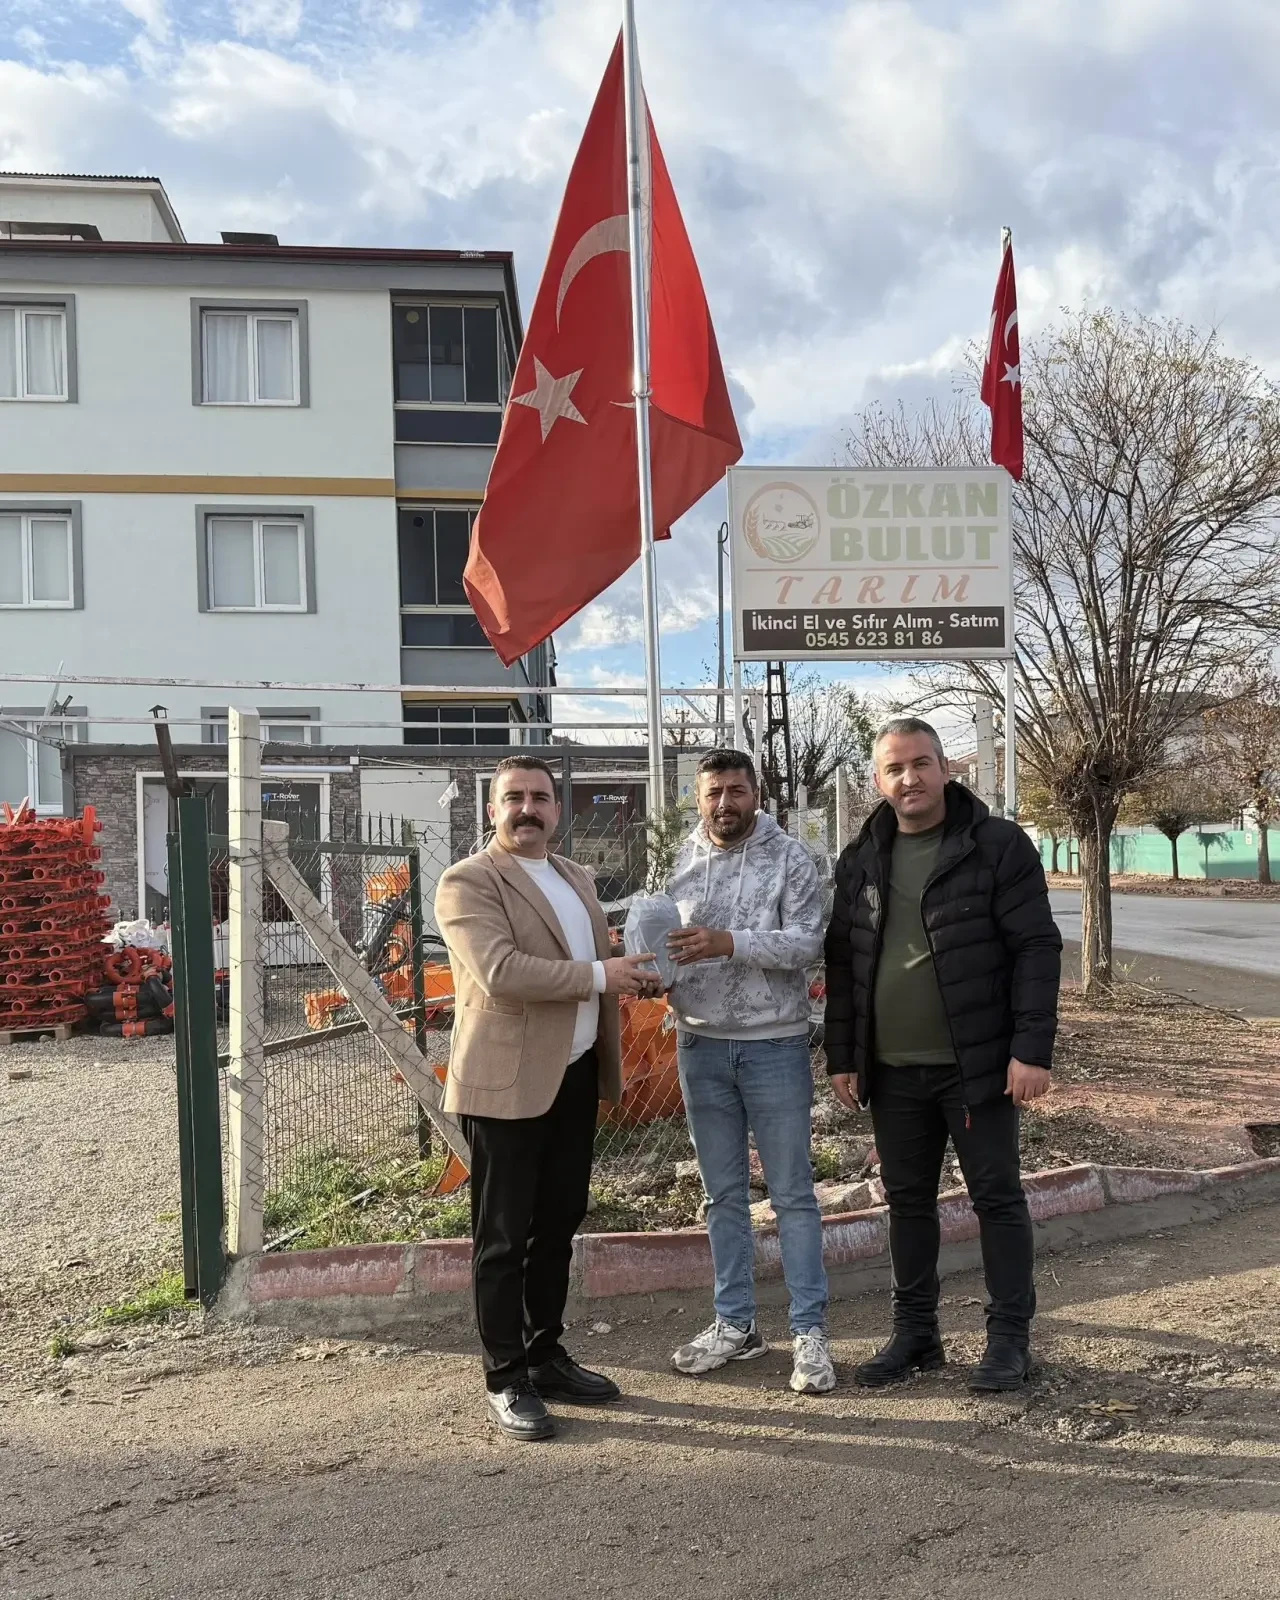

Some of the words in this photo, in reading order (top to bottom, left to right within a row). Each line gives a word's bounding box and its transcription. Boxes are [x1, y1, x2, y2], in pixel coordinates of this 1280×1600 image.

[826, 477, 998, 519] ÖZKAN
[829, 525, 999, 562] BULUT
[775, 574, 971, 605] TARIM
[752, 611, 797, 631] İkinci
[803, 615, 820, 630] El
[825, 618, 847, 630] ve
[852, 614, 888, 630] Sıfır
[893, 612, 934, 629] Alım
[949, 613, 999, 628] Satım
[806, 632, 849, 647] 0545
[855, 631, 888, 646] 623
[894, 631, 914, 646] 81
[921, 631, 943, 646] 86
